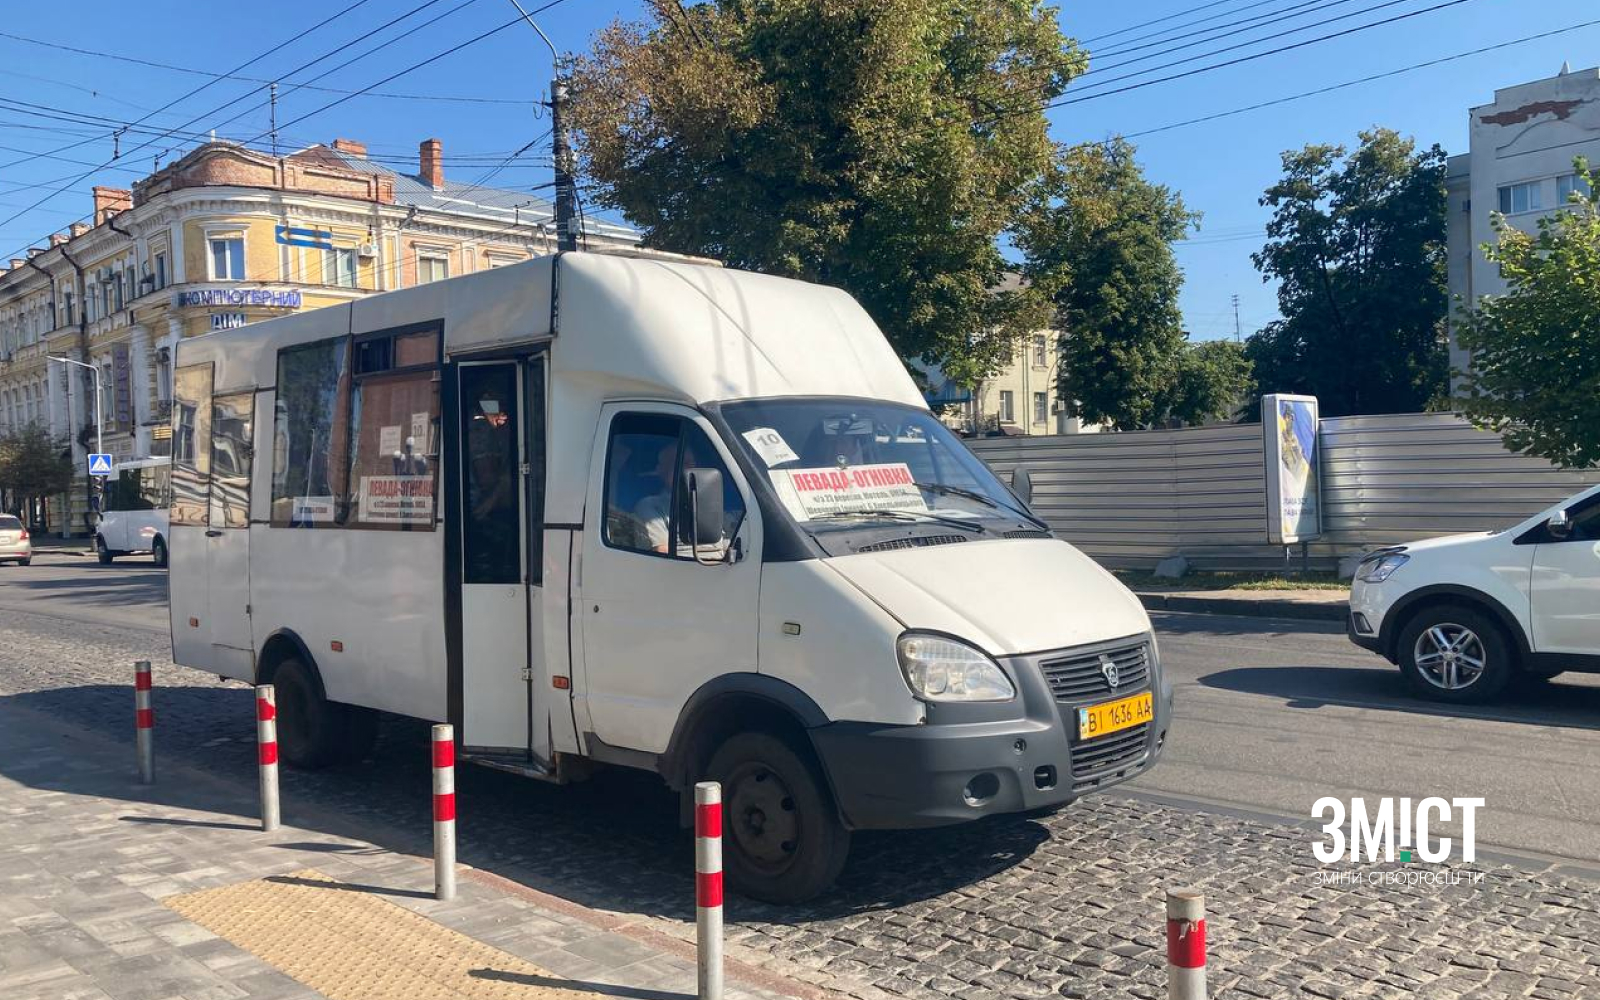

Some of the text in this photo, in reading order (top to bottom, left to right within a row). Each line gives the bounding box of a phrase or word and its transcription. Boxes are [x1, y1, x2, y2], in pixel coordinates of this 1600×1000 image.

[757, 433, 781, 446] 10
[792, 467, 913, 493] ЛЕВАДА-ОГНІВКА
[1109, 703, 1132, 726] 1636
